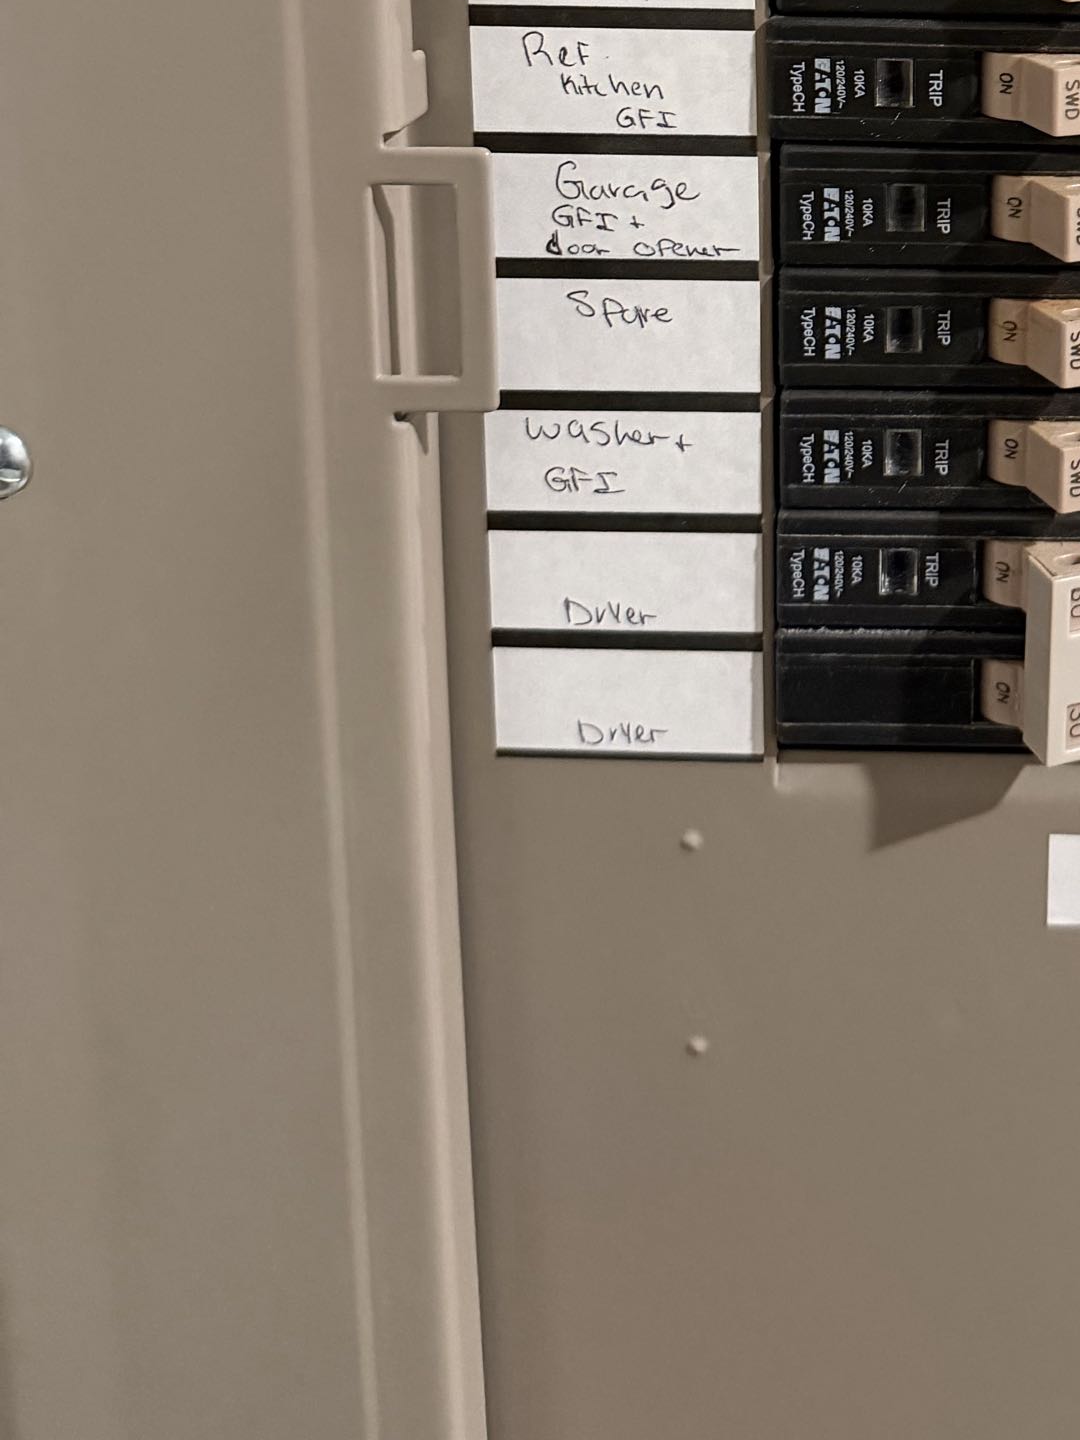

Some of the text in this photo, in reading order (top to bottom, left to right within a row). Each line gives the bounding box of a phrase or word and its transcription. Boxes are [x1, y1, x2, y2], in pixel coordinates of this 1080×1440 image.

[928, 69, 944, 108] TRIP
[1064, 79, 1080, 121] SWD
[616, 107, 678, 129] GFI
[555, 160, 701, 210] Garage
[551, 204, 618, 232] GFI
[544, 466, 626, 495] GFI
